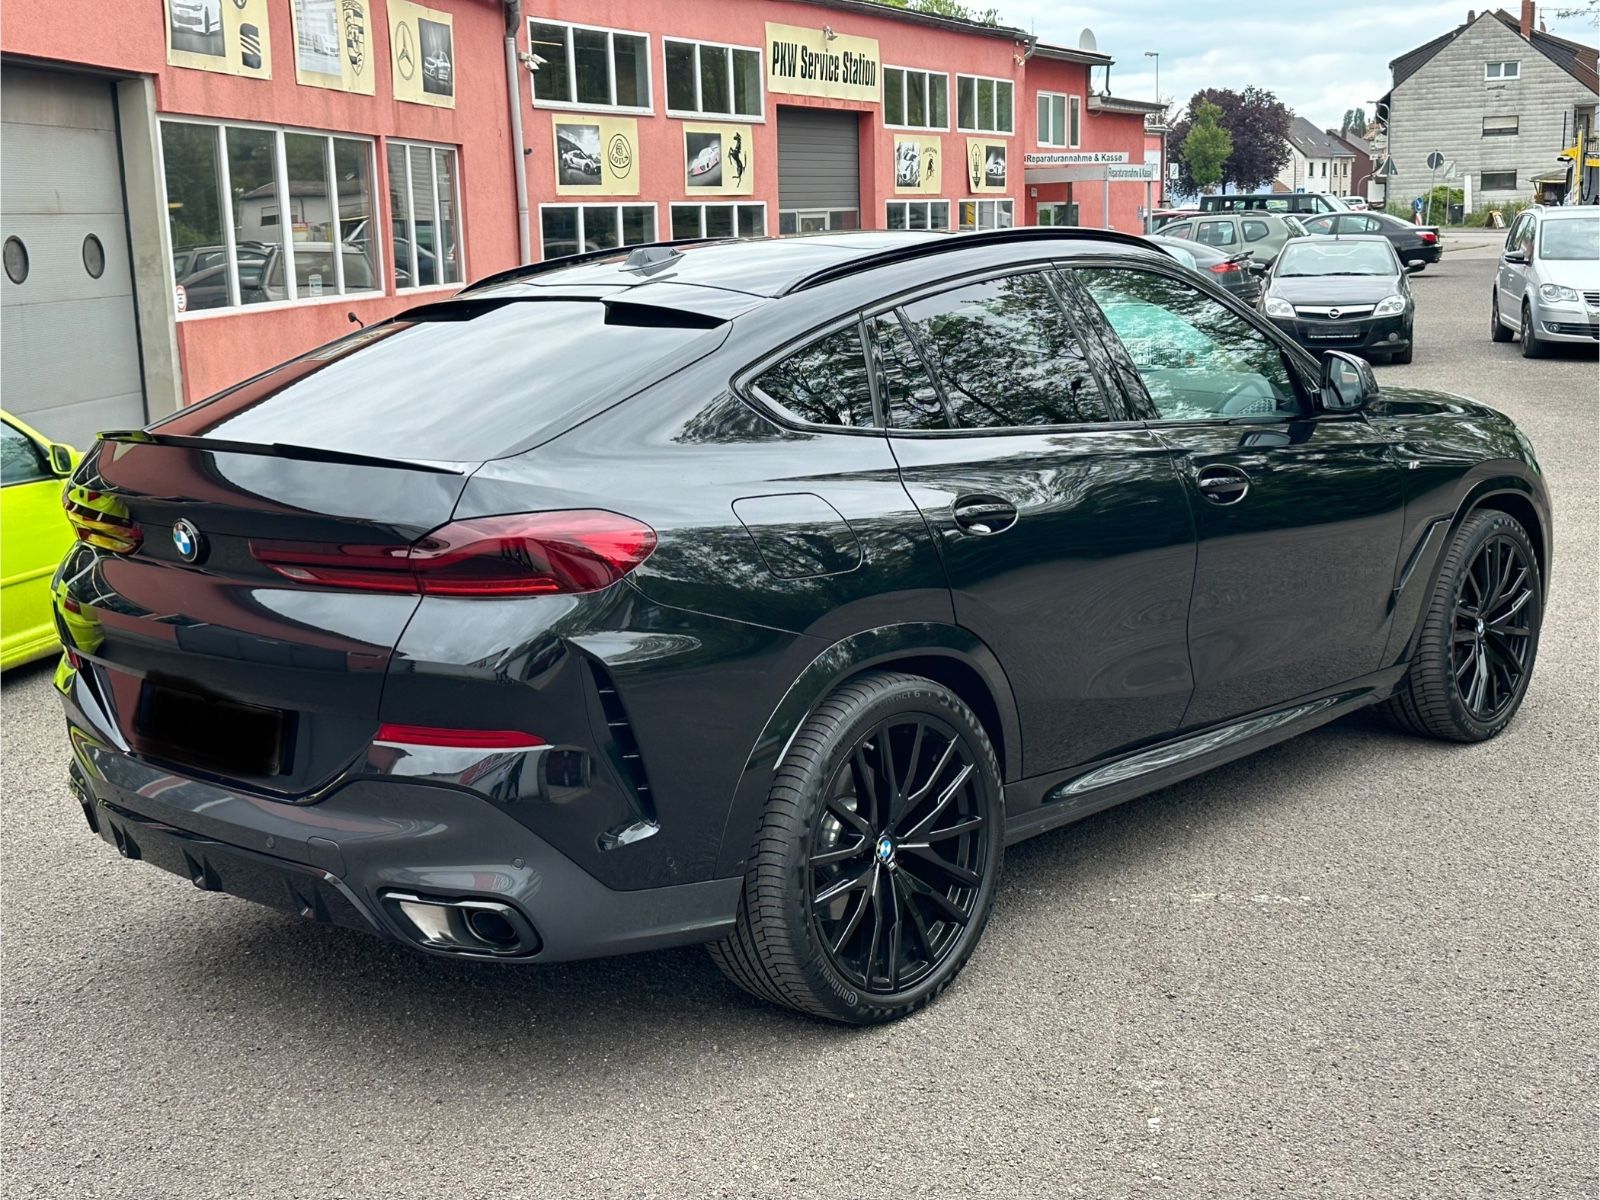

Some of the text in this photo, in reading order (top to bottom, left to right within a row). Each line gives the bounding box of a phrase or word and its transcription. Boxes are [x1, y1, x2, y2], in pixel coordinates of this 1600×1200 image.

[772, 41, 876, 87] PKW Service Station
[1026, 155, 1092, 163] Reparaturannahme
[1101, 154, 1123, 162] Kasse
[813, 954, 858, 1007] Continental
